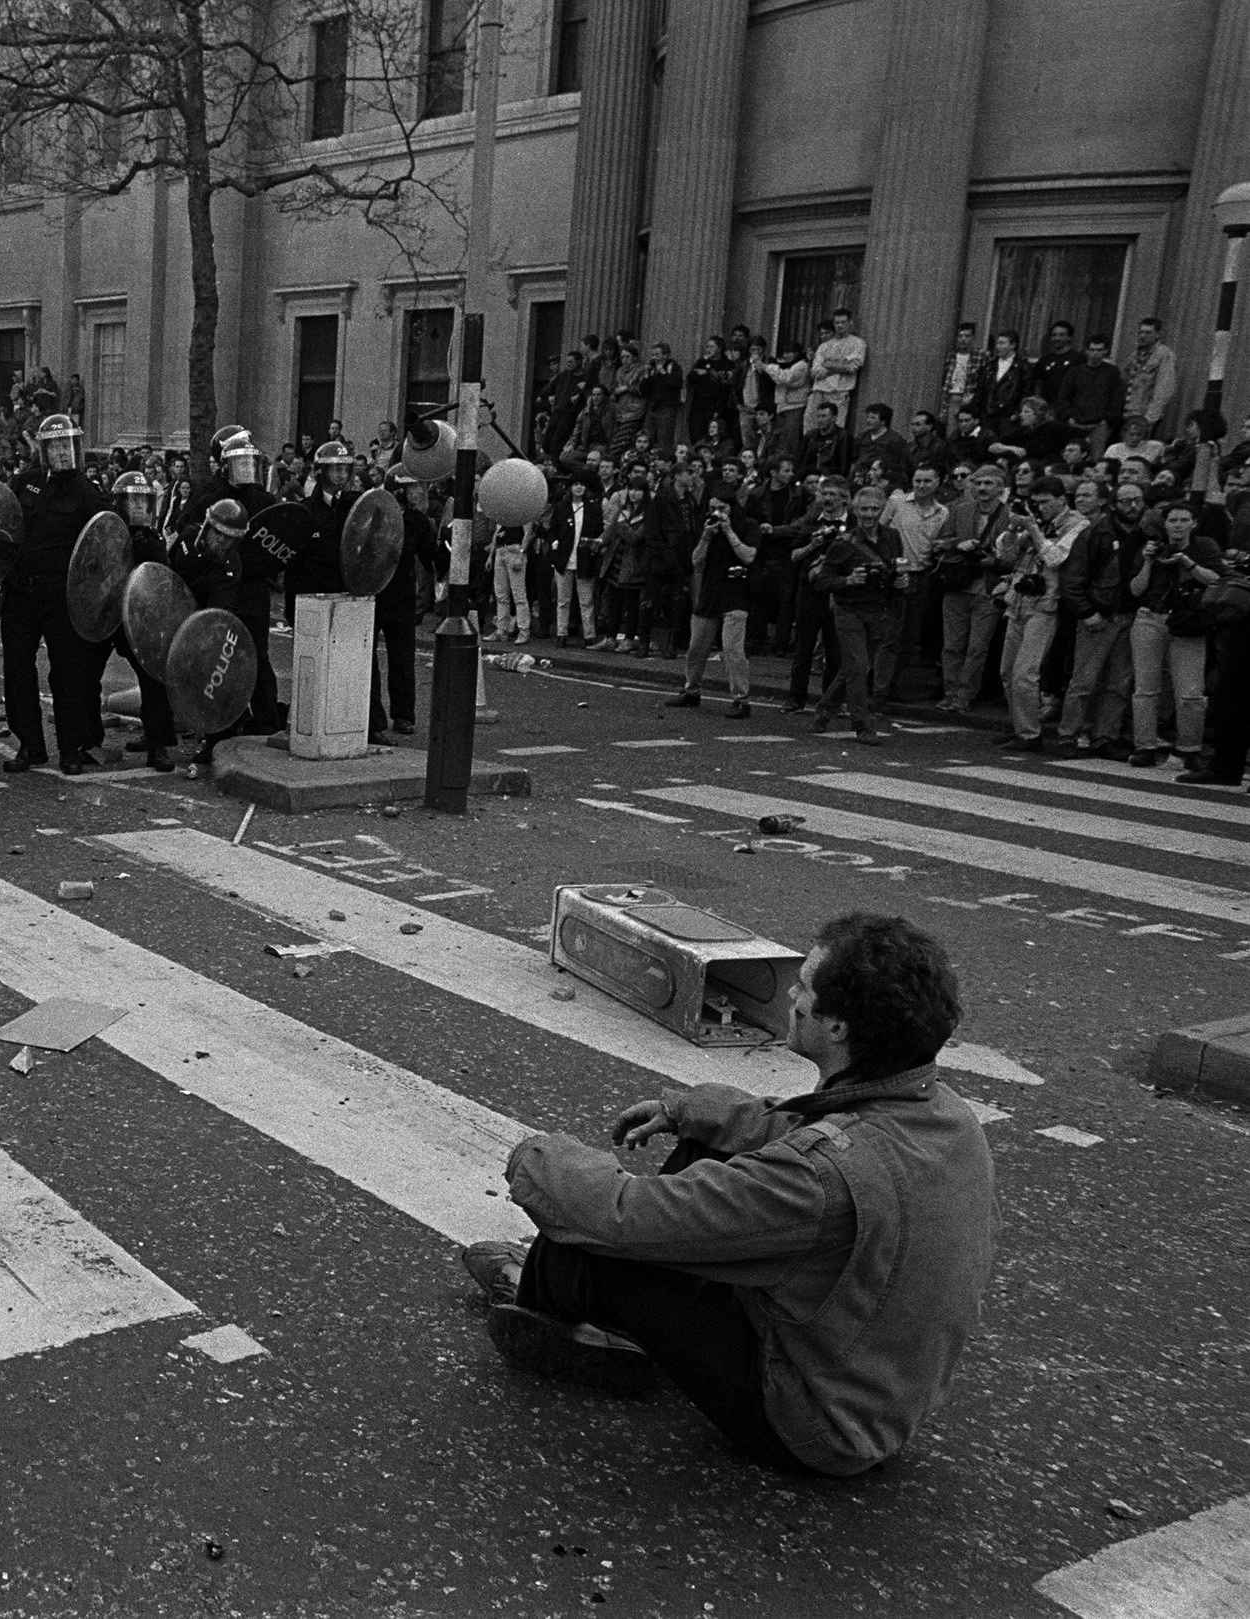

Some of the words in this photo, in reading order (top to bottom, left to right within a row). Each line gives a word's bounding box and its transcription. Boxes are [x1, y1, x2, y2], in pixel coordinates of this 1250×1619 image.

[26, 484, 41, 494] POLICE
[252, 526, 296, 564] POLICE
[203, 629, 238, 701] POLICE
